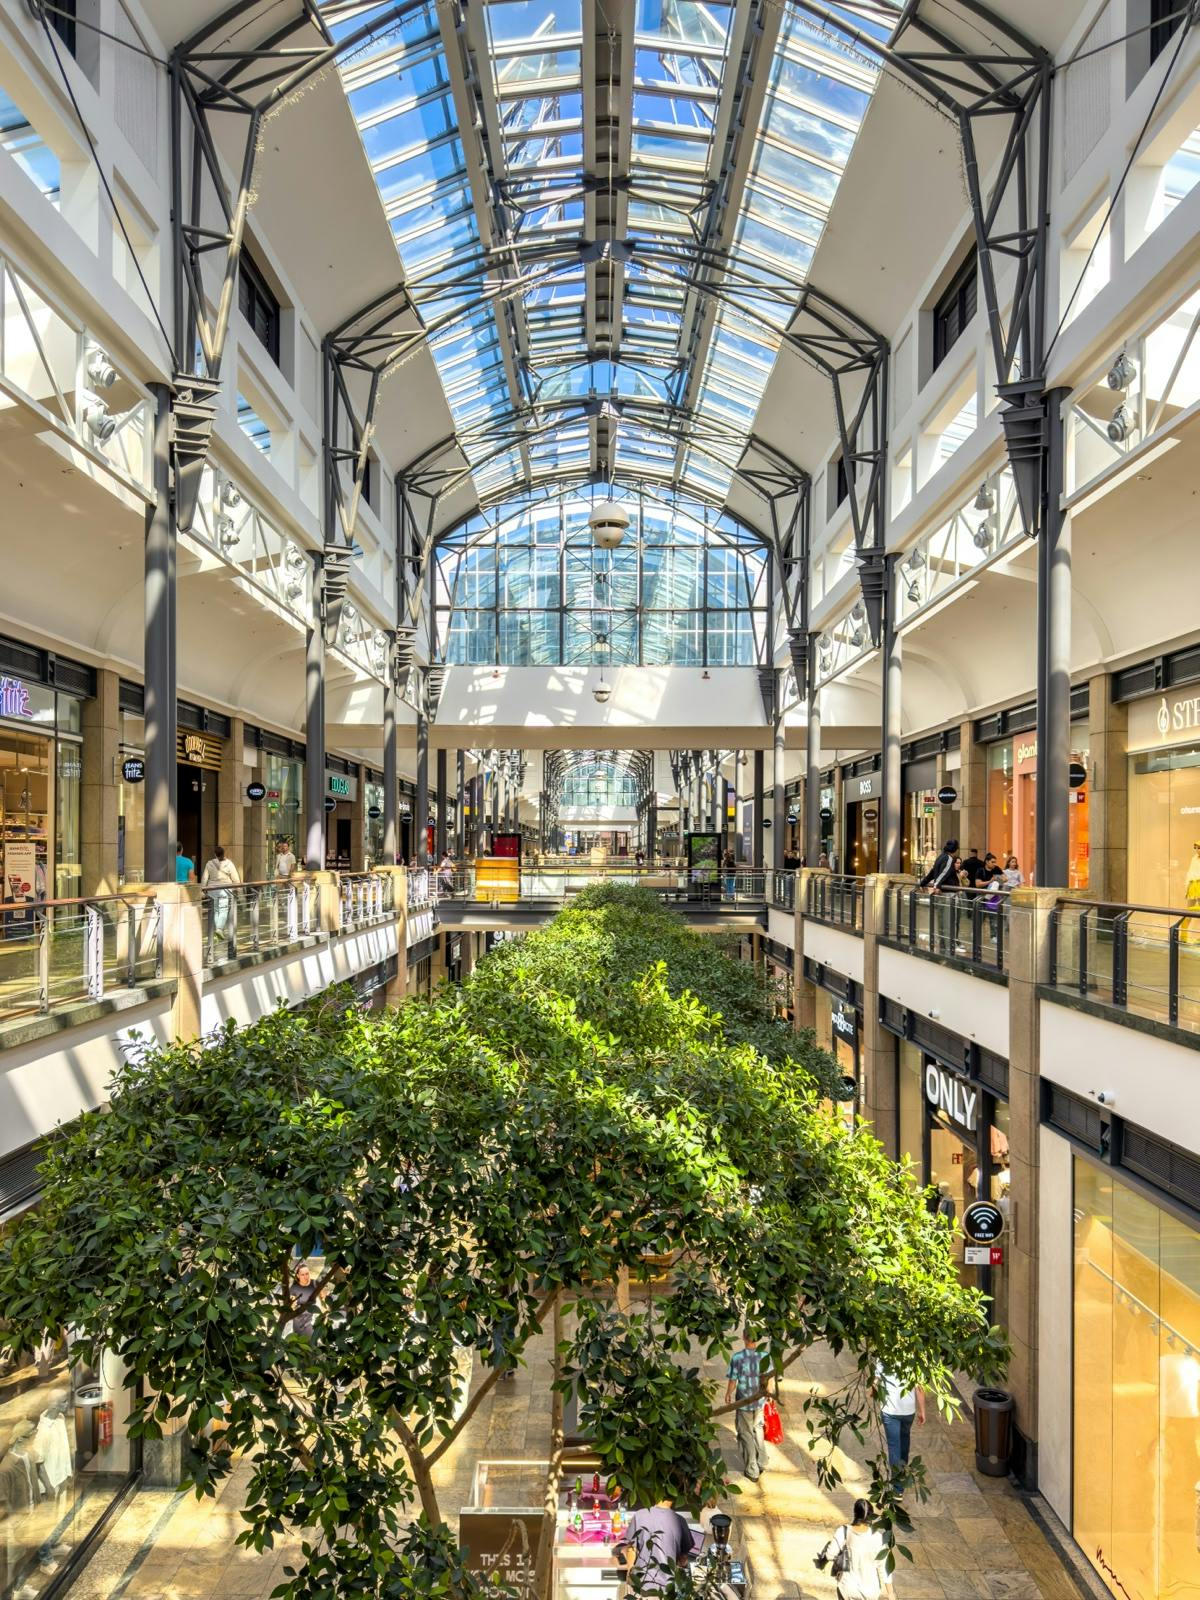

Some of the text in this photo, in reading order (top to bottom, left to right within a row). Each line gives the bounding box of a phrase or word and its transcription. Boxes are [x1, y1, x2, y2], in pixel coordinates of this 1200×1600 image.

[125, 768, 144, 779] fritz
[860, 780, 872, 795] BOSS
[926, 1064, 976, 1130] ONLY
